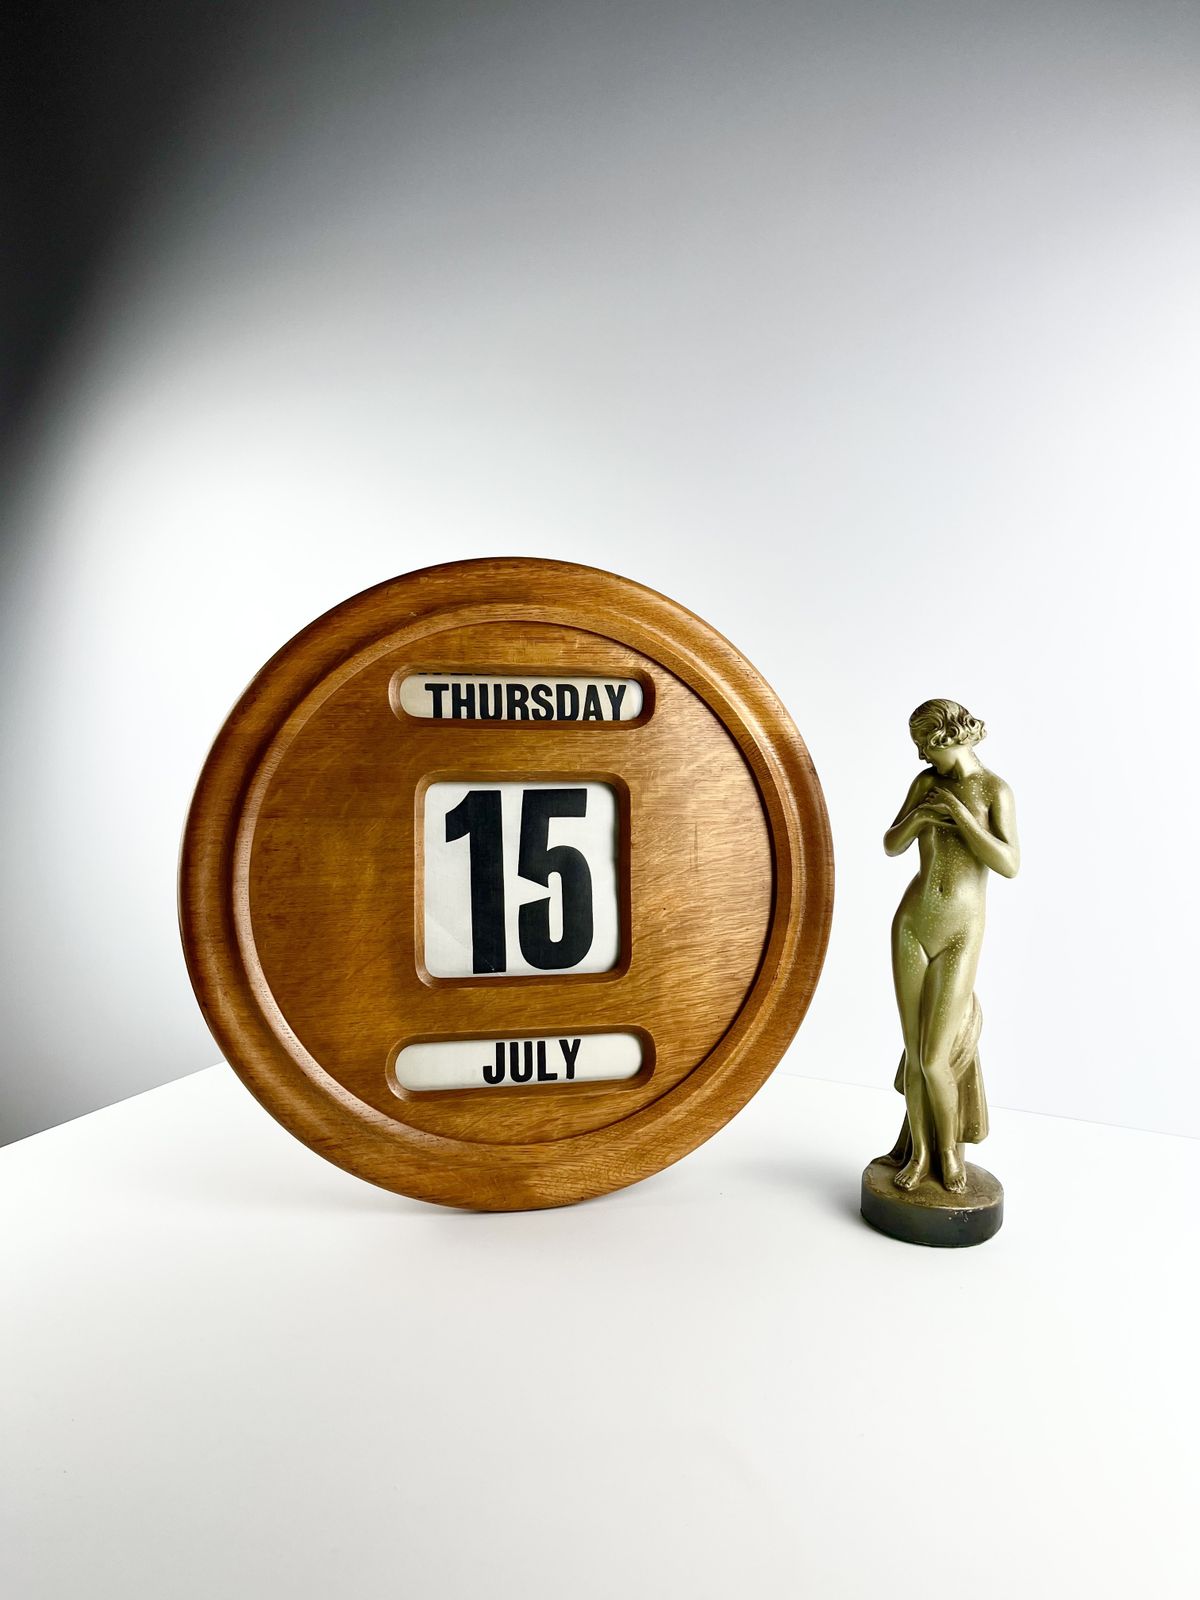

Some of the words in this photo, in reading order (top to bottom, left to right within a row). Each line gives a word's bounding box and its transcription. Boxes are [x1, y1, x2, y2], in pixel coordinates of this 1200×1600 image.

[424, 683, 627, 721] THURSDAY
[445, 788, 594, 974] 15
[482, 1038, 582, 1085] JULY
